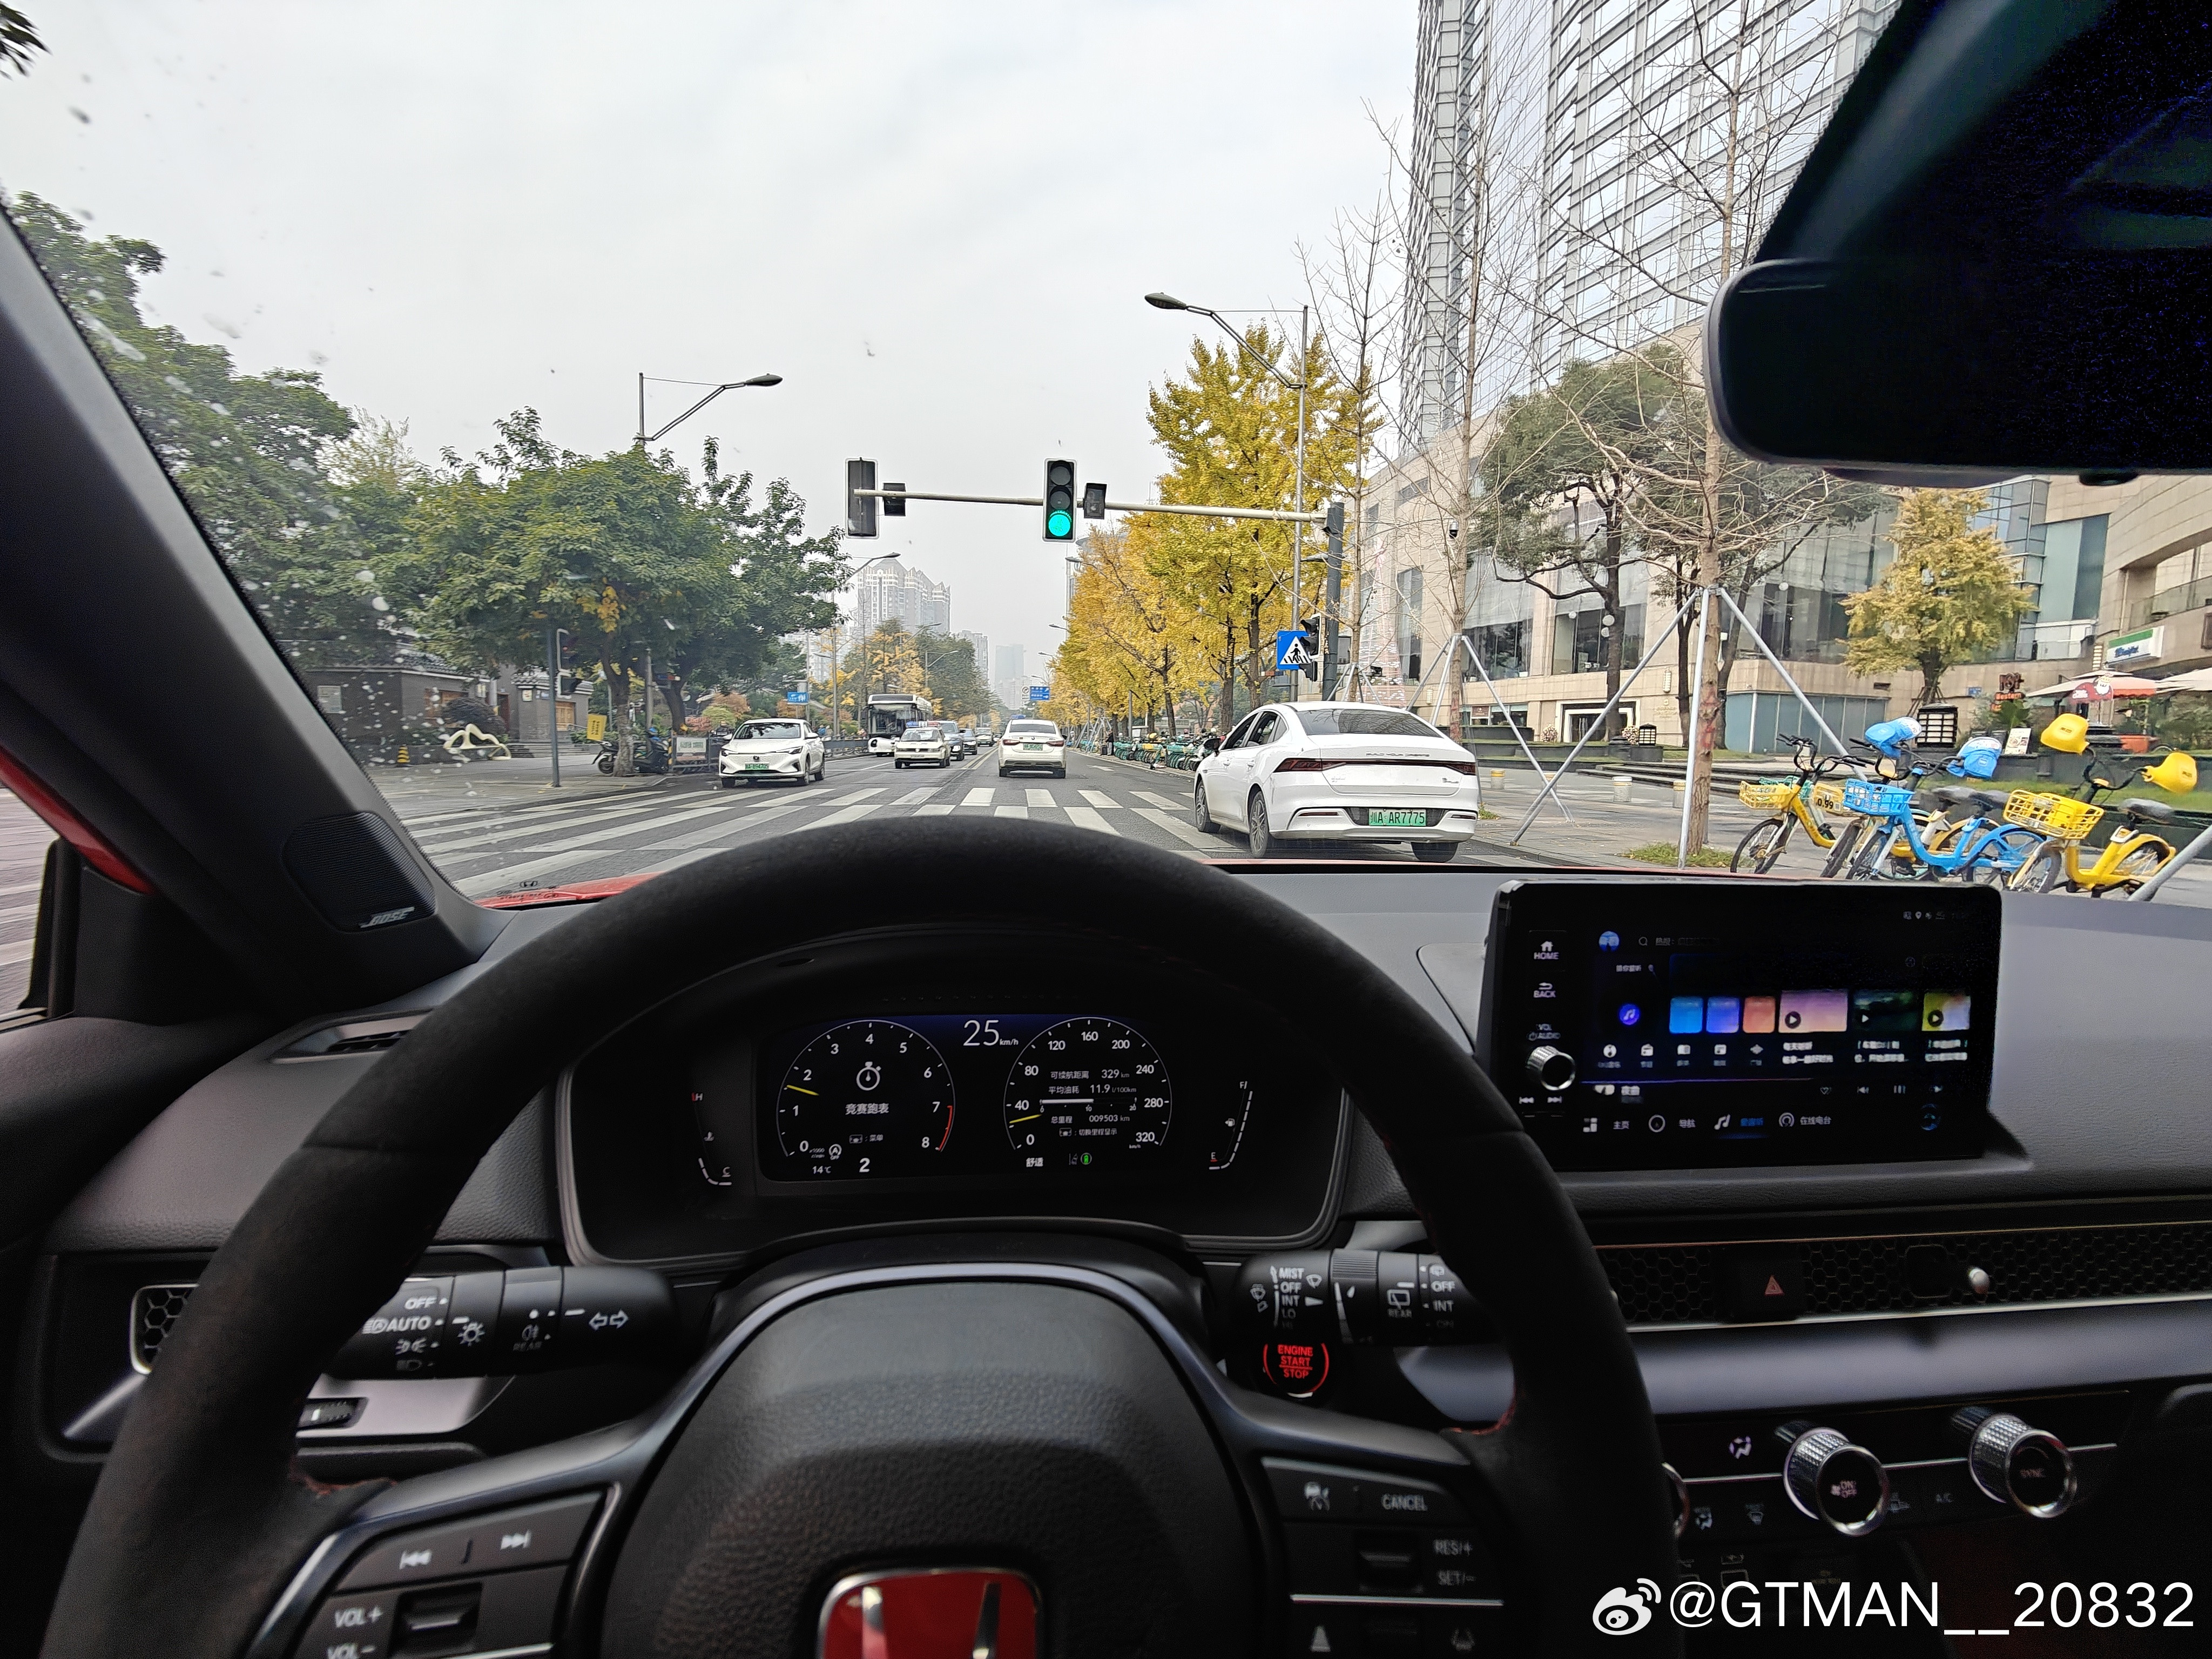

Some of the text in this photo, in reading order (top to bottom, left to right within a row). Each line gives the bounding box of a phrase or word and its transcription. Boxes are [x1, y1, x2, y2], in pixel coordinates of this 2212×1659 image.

[1533, 990, 1556, 998] BACK
[865, 1034, 874, 1044] 4
[963, 1020, 1019, 1047] 25 km/h
[1081, 1031, 1098, 1041] 160
[830, 1043, 839, 1054] 3
[899, 1042, 907, 1053] 5
[1048, 1040, 1066, 1050] 120
[1111, 1040, 1130, 1049] 200
[923, 1067, 932, 1078] 6
[1024, 1065, 1038, 1076] 80
[1101, 1069, 1120, 1078] 329
[1136, 1064, 1155, 1074] 240
[803, 1069, 812, 1081] 2
[1050, 1071, 1089, 1080] 可续航距离
[1048, 1085, 1080, 1094] 平均油耗
[1090, 1084, 1110, 1094] 11.9
[695, 1093, 703, 1101] H
[932, 1102, 940, 1112] 7
[1015, 1100, 1029, 1110] 40
[1144, 1098, 1163, 1108] 280
[793, 1105, 799, 1116] 1
[845, 1103, 889, 1115] 竞赛跑表
[1051, 1116, 1073, 1124] 总里程
[1613, 1121, 1630, 1130] 主页
[1679, 1118, 1696, 1128] 导航
[1800, 1116, 1832, 1125] 在线电台
[921, 1137, 930, 1148] 8
[1026, 1134, 1034, 1145] 0
[1135, 1132, 1155, 1142] 320
[799, 1140, 809, 1152] 0
[1211, 1152, 1216, 1160] E
[859, 1158, 870, 1172] 2
[1026, 1157, 1043, 1167] 舒适
[1278, 1267, 1304, 1279] MIST
[1280, 1282, 1302, 1294] OFF
[1431, 1280, 1455, 1292] OFF
[404, 1296, 436, 1310] OFF
[1282, 1294, 1300, 1307] INT
[1433, 1300, 1454, 1312] INT
[1282, 1308, 1296, 1319] LO
[1387, 1308, 1412, 1318] REAR
[386, 1316, 431, 1332] AUTO
[1277, 1344, 1313, 1357] ENGINE
[1280, 1355, 1311, 1366] START
[1284, 1368, 1309, 1379] STOP
[1381, 1493, 1427, 1512] CANCEL
